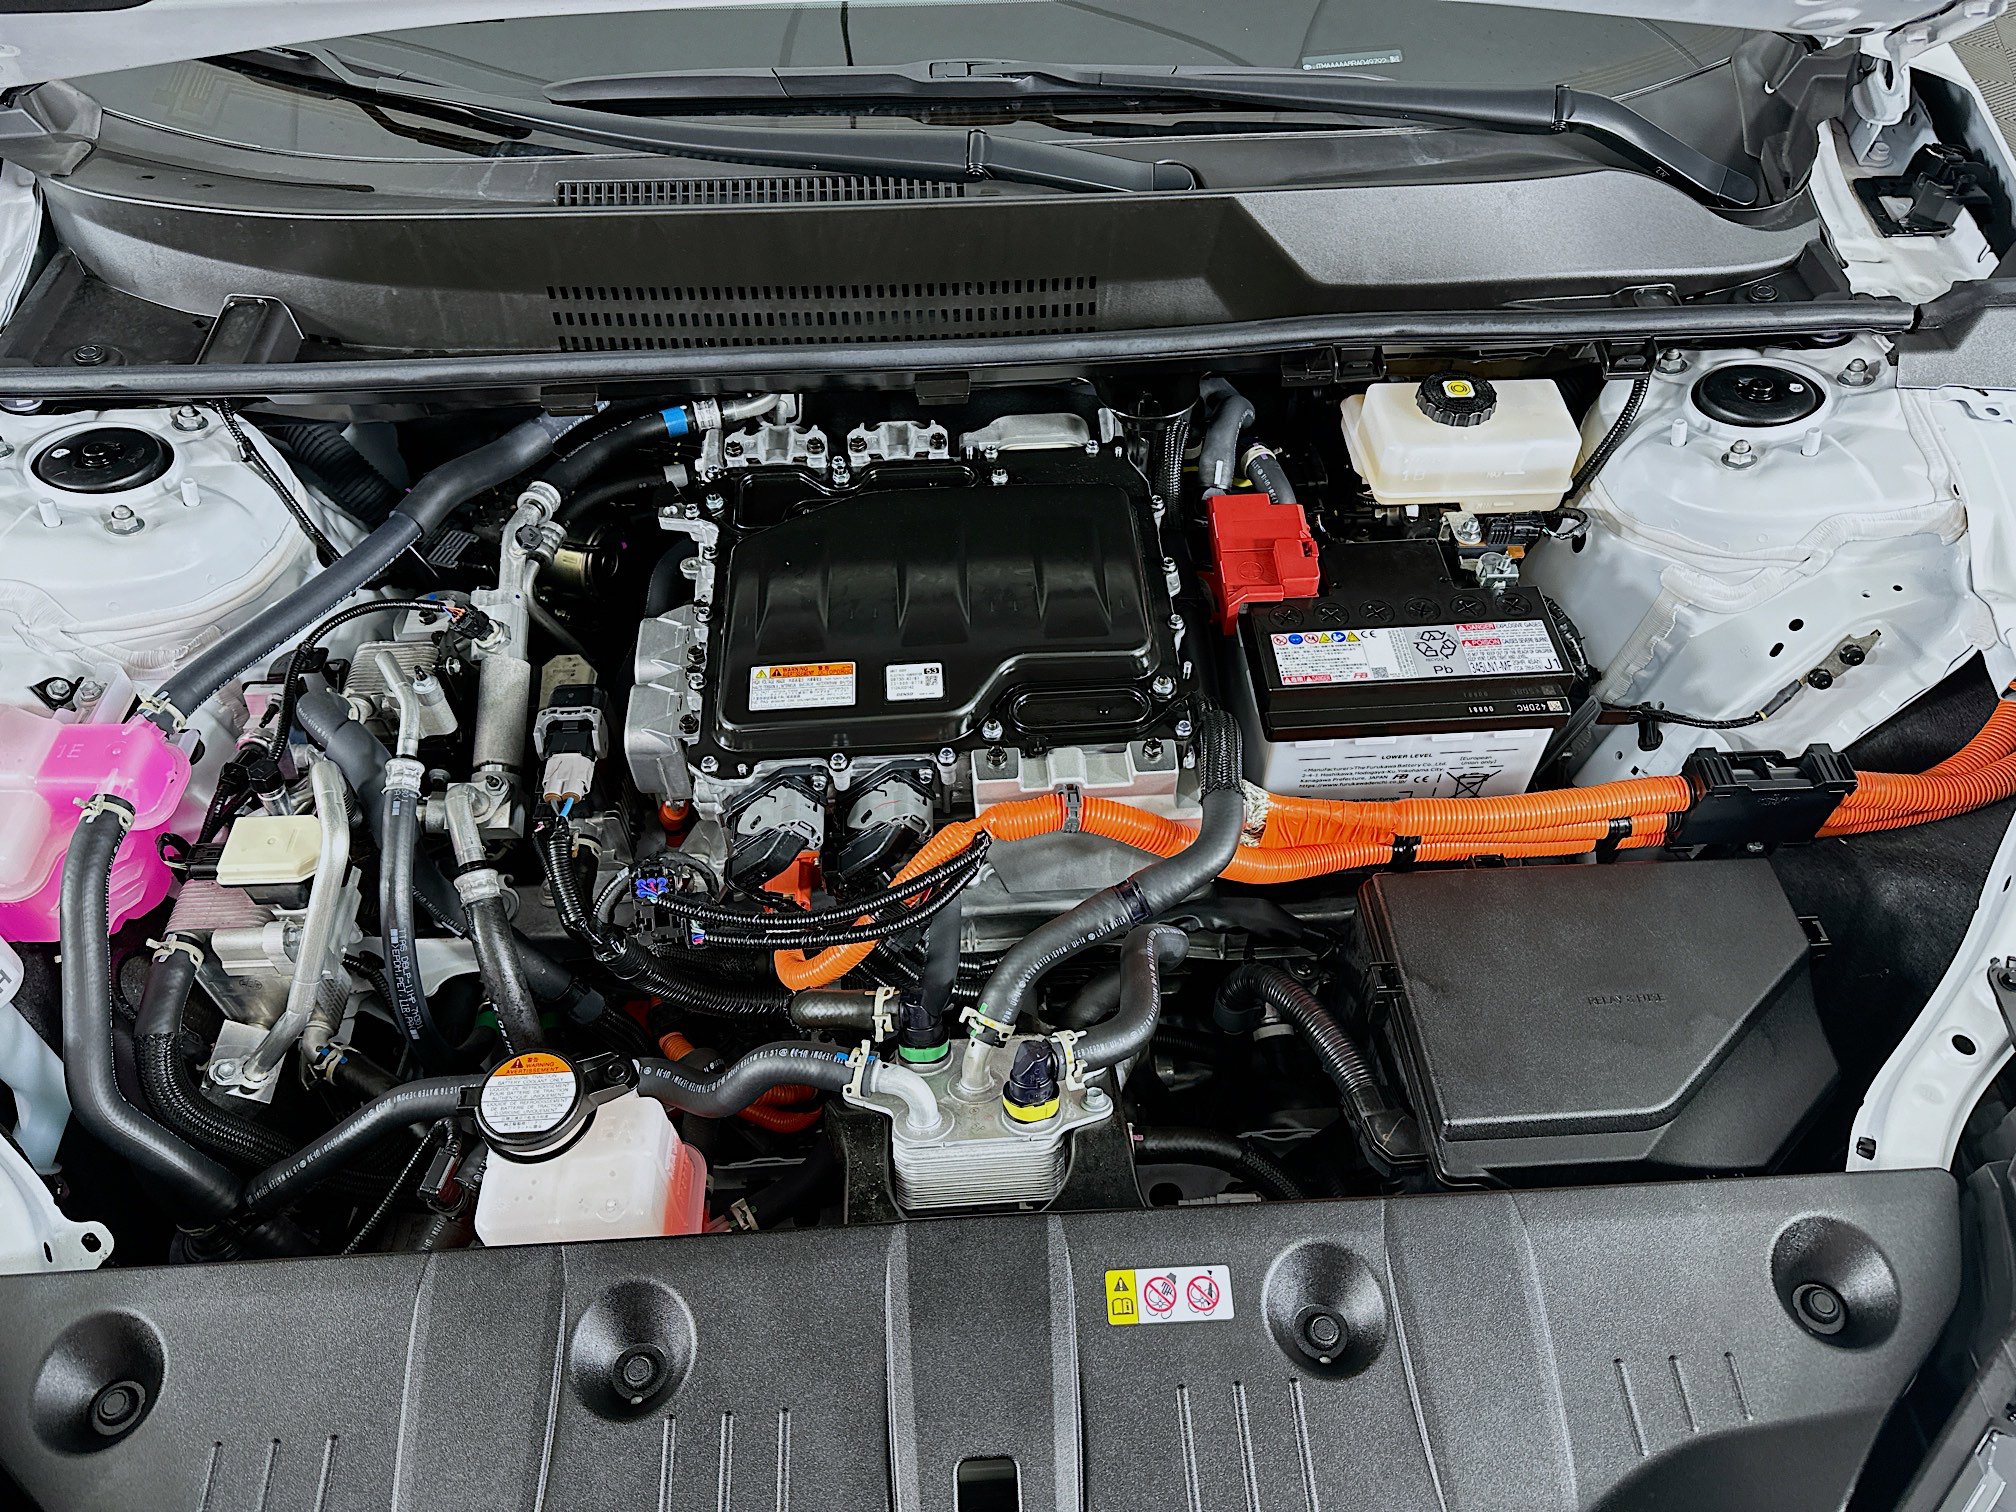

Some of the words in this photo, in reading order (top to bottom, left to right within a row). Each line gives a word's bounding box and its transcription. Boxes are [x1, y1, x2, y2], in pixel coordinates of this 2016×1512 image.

[1467, 623, 1495, 631] DANGER
[1472, 638, 1501, 646] POISON
[1545, 658, 1561, 670] J1
[1433, 665, 1454, 675] Pb
[1034, 955, 1051, 970] WATER
[506, 1066, 559, 1075] AVERTISSEMENT
[417, 1088, 440, 1098] WATER
